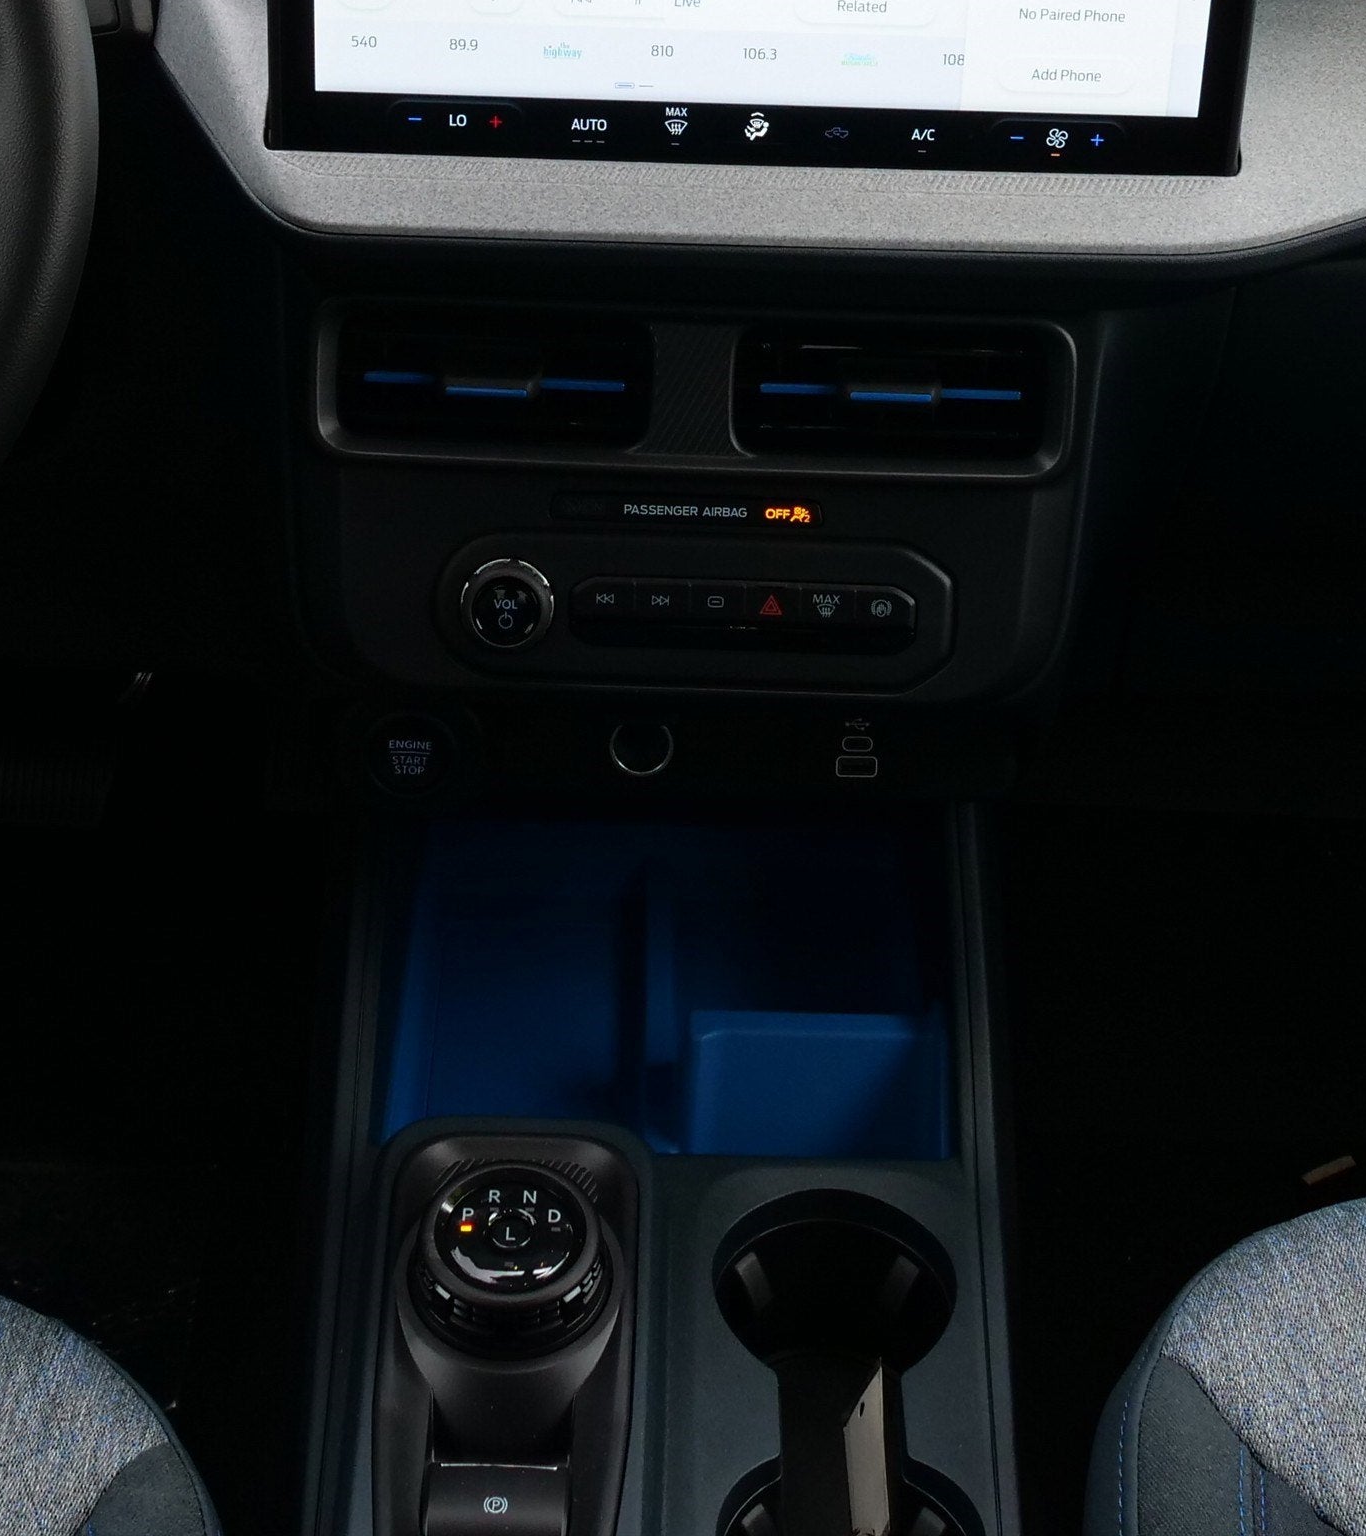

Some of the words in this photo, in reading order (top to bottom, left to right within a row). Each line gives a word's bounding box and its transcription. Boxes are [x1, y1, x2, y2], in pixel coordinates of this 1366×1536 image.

[836, 0, 888, 14] Related
[1018, 7, 1037, 21] No
[1040, 8, 1081, 22] Paired
[1083, 9, 1126, 24] Phone
[351, 35, 378, 49] 540
[448, 37, 479, 52] 89.9
[543, 45, 582, 59] highway
[650, 44, 674, 58] 810
[742, 46, 778, 62] 106.3
[1031, 68, 1057, 82] Add
[1059, 69, 1102, 84] Phone
[665, 107, 688, 118] MAX
[448, 114, 468, 128] LO
[571, 117, 607, 132] AUTO
[911, 127, 936, 143] A/C
[623, 504, 699, 517] PASSENGER
[702, 506, 748, 519] AIRBAG
[765, 508, 791, 520] OFF
[493, 599, 518, 610] VOL
[812, 594, 841, 605] MAX
[389, 739, 433, 750] ENGINE
[392, 755, 427, 765] START
[394, 765, 425, 775] STOP
[488, 1189, 501, 1203] R
[523, 1190, 537, 1204] N
[462, 1207, 475, 1221] P
[548, 1209, 562, 1223] D
[505, 1226, 516, 1241] L
